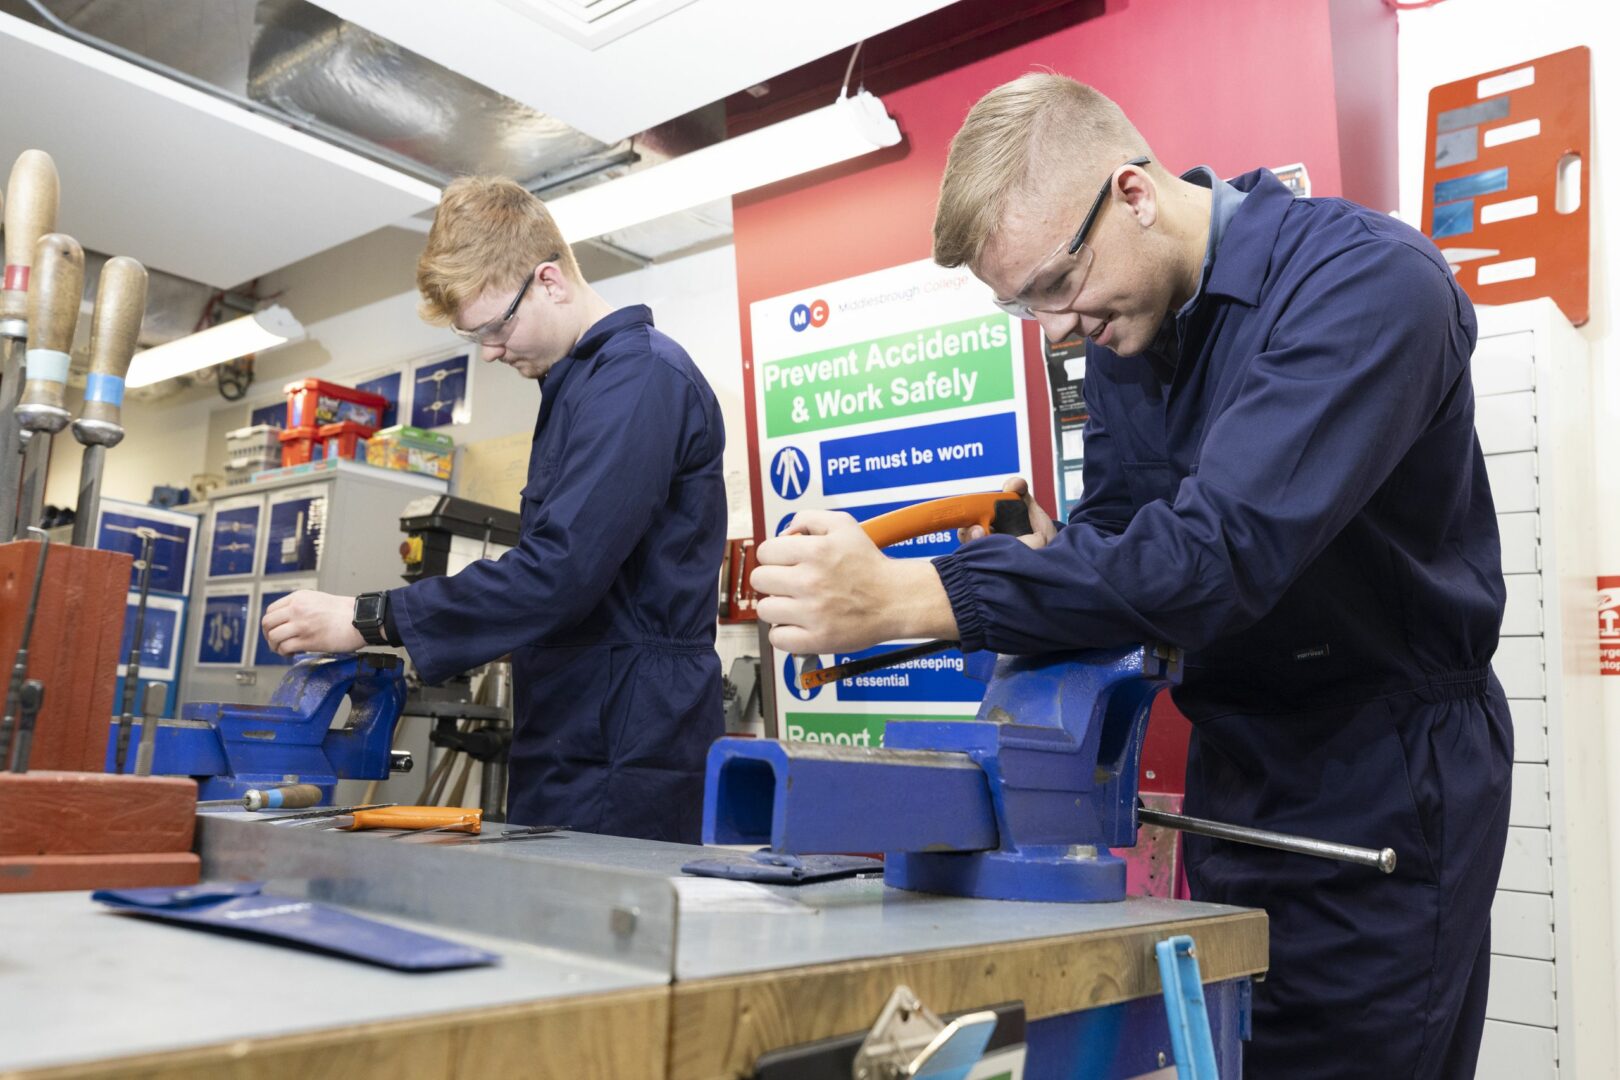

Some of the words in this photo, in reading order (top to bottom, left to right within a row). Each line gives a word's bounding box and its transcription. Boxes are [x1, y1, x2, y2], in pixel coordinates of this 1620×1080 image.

[838, 286, 920, 312] Middlesbrough
[924, 275, 969, 294] College
[792, 303, 826, 328] MC
[764, 349, 859, 392] Prevent
[865, 322, 1008, 372] Accidents
[791, 395, 810, 424] &
[815, 384, 884, 419] Work
[890, 367, 978, 406] Safely
[827, 455, 861, 476] PPE
[865, 449, 908, 471] must
[911, 447, 933, 465] be
[937, 442, 984, 461] worn
[916, 531, 952, 545] areas
[856, 674, 909, 687] essential
[788, 725, 871, 747] Report
